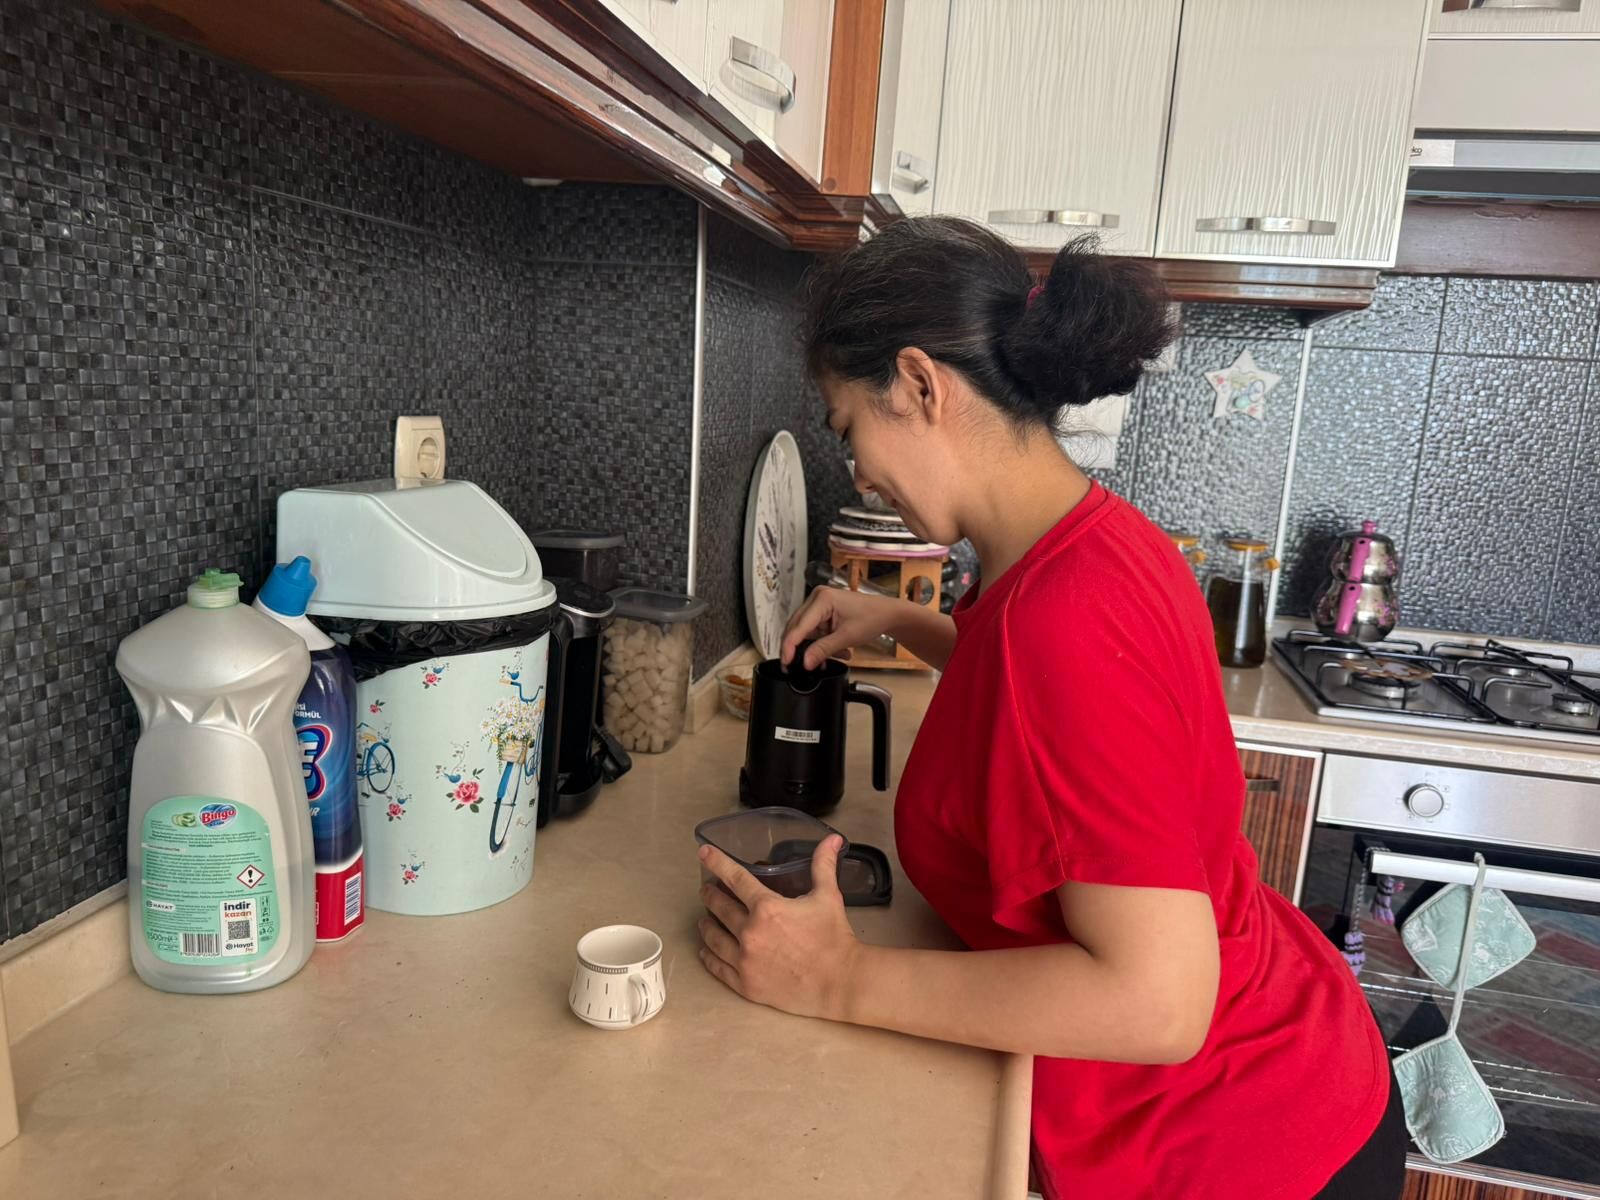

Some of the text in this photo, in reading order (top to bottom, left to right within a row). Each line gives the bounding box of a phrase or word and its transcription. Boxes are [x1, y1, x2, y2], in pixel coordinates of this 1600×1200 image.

[294, 710, 322, 719] ORMÜL
[201, 809, 237, 824] Bingo
[224, 901, 251, 911] indir
